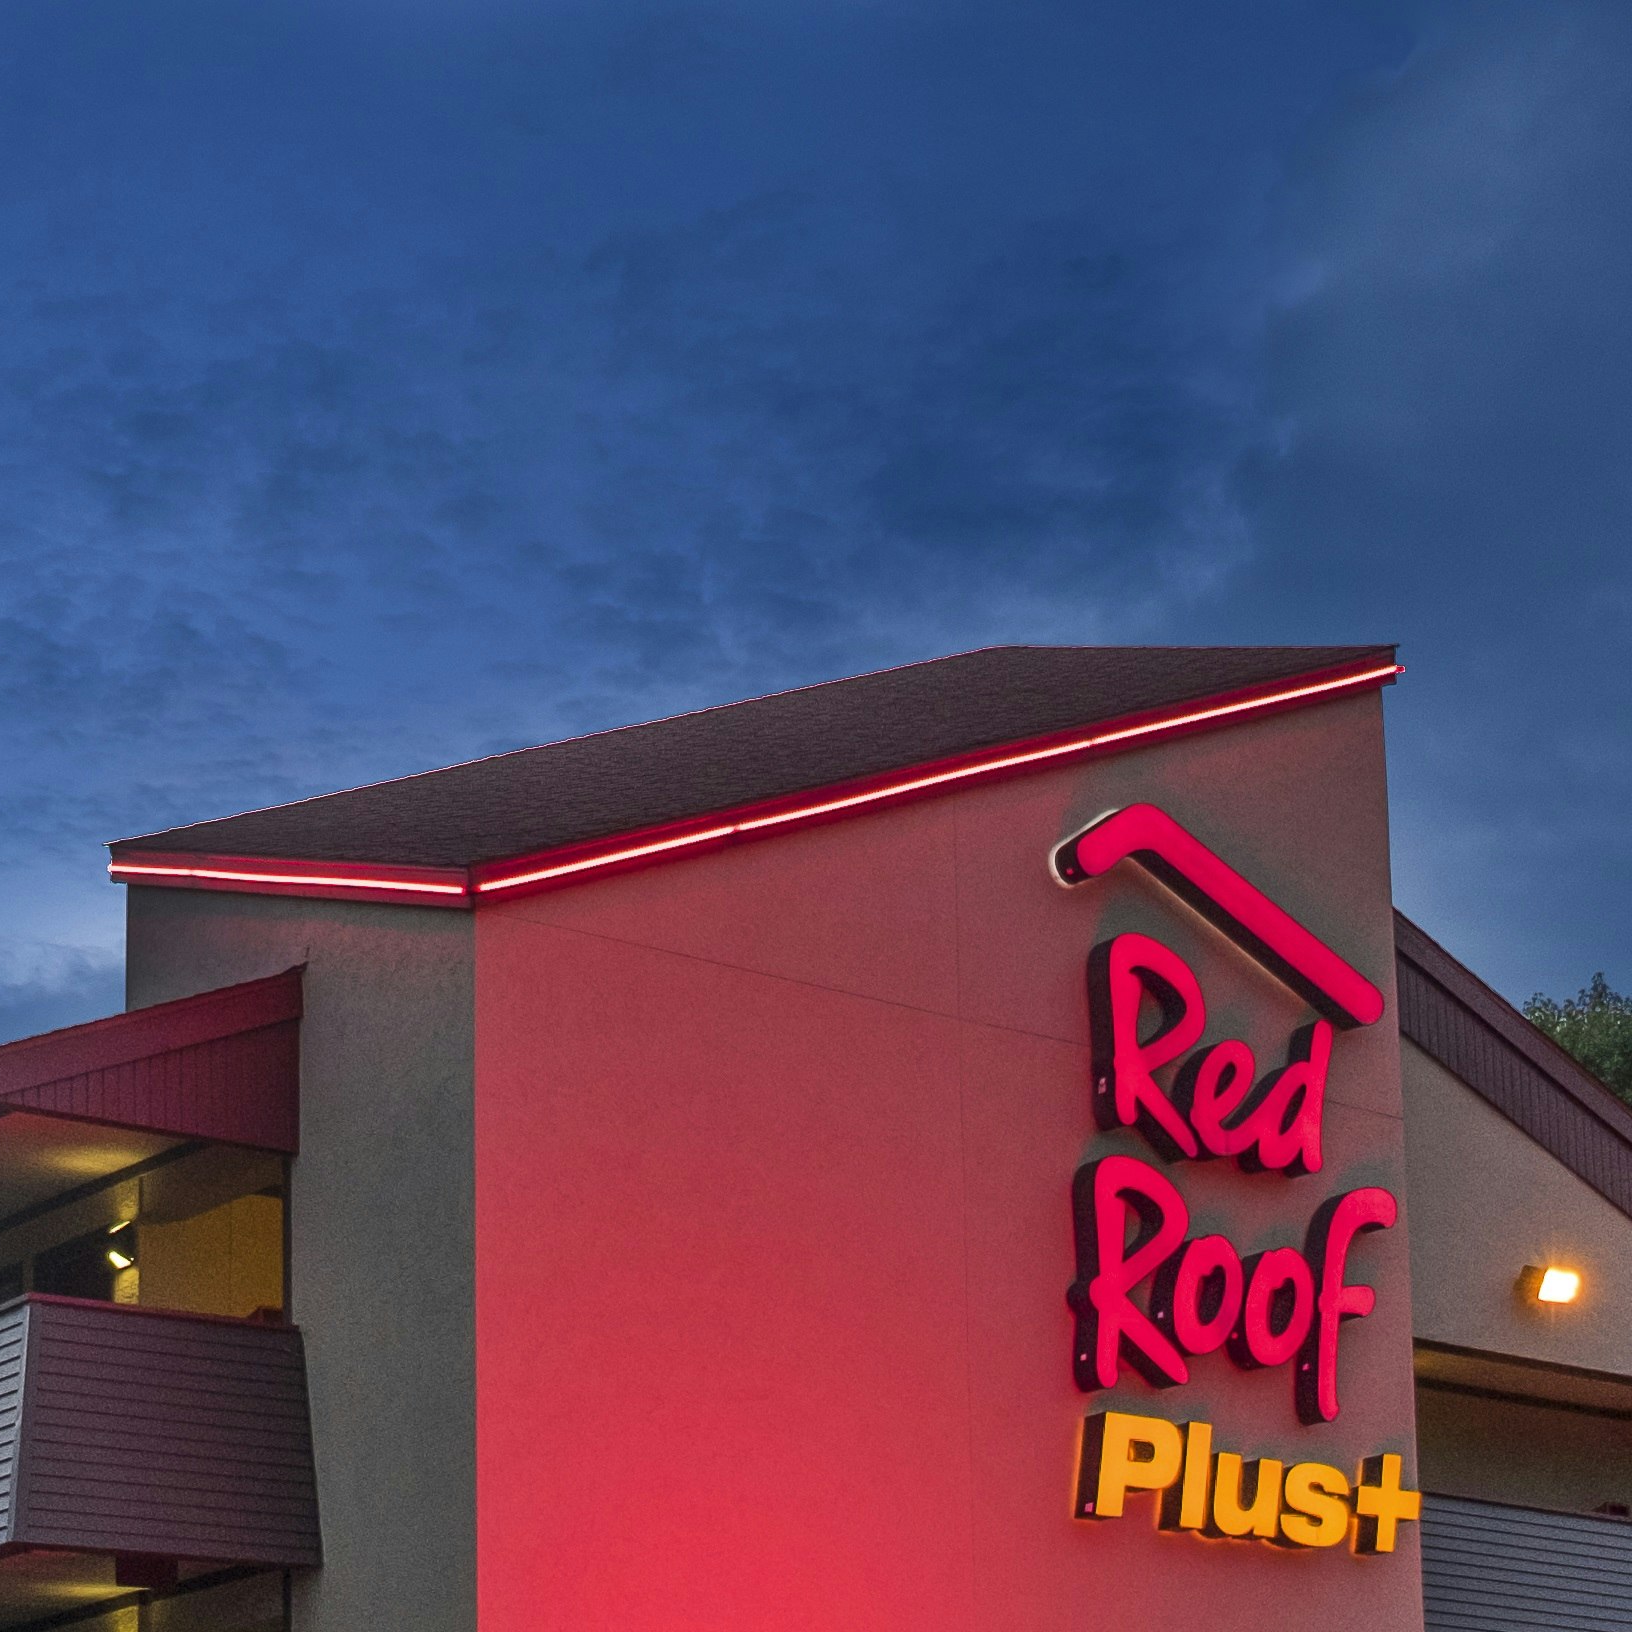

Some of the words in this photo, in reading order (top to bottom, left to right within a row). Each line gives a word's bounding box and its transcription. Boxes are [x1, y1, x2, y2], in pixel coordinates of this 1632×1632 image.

[1089, 933, 1333, 1174] Red
[1069, 1155, 1398, 1424] Roof
[1074, 1411, 1421, 1554] Plus+
